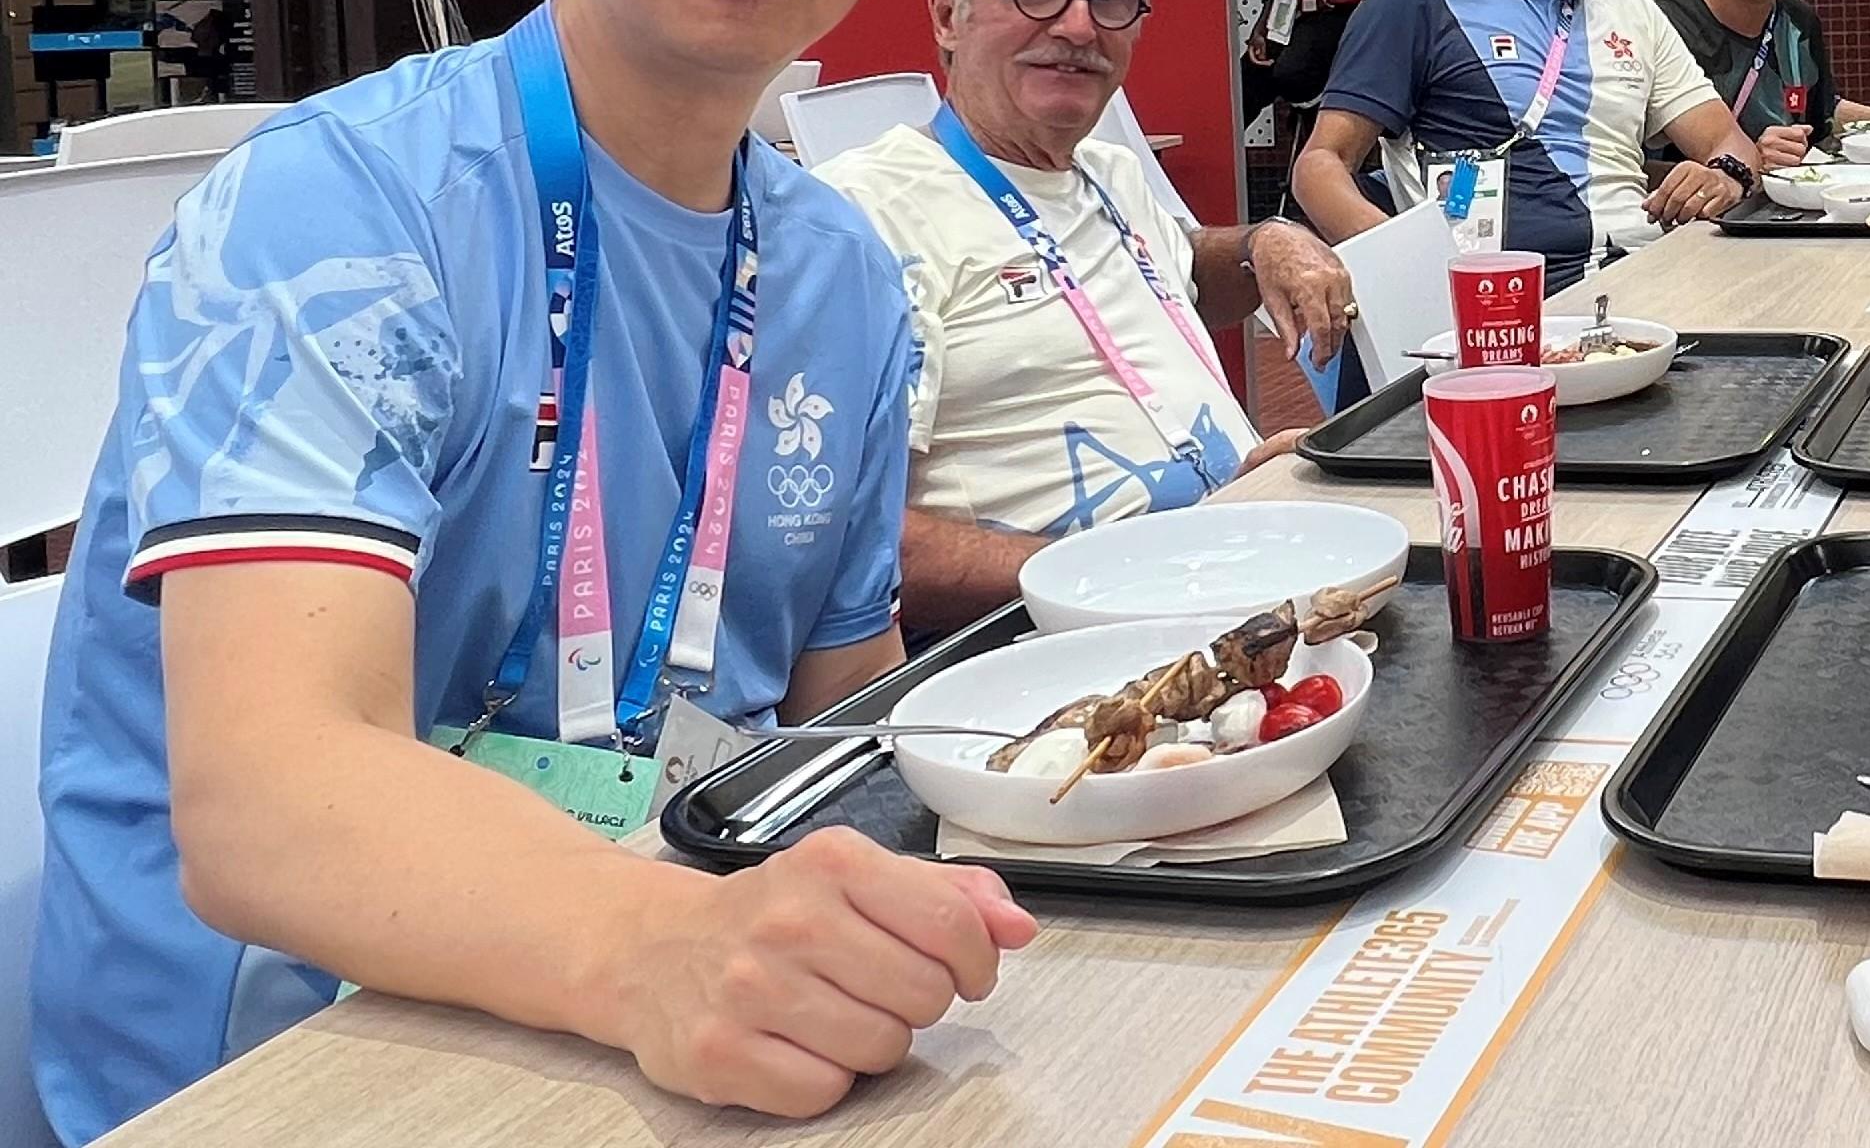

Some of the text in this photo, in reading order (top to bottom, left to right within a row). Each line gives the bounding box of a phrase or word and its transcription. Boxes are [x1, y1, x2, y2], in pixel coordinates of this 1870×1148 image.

[1466, 325, 1535, 348] CHASING
[1482, 347, 1523, 362] DREAMS
[542, 453, 573, 587] PARIS 2024
[704, 385, 740, 555] PARIS 2024
[573, 525, 595, 620] PARIS
[650, 509, 695, 632] PARIS 2024
[1242, 910, 1449, 1095] THE ATHLETE365
[1324, 950, 1494, 1104] COMMUNITY
